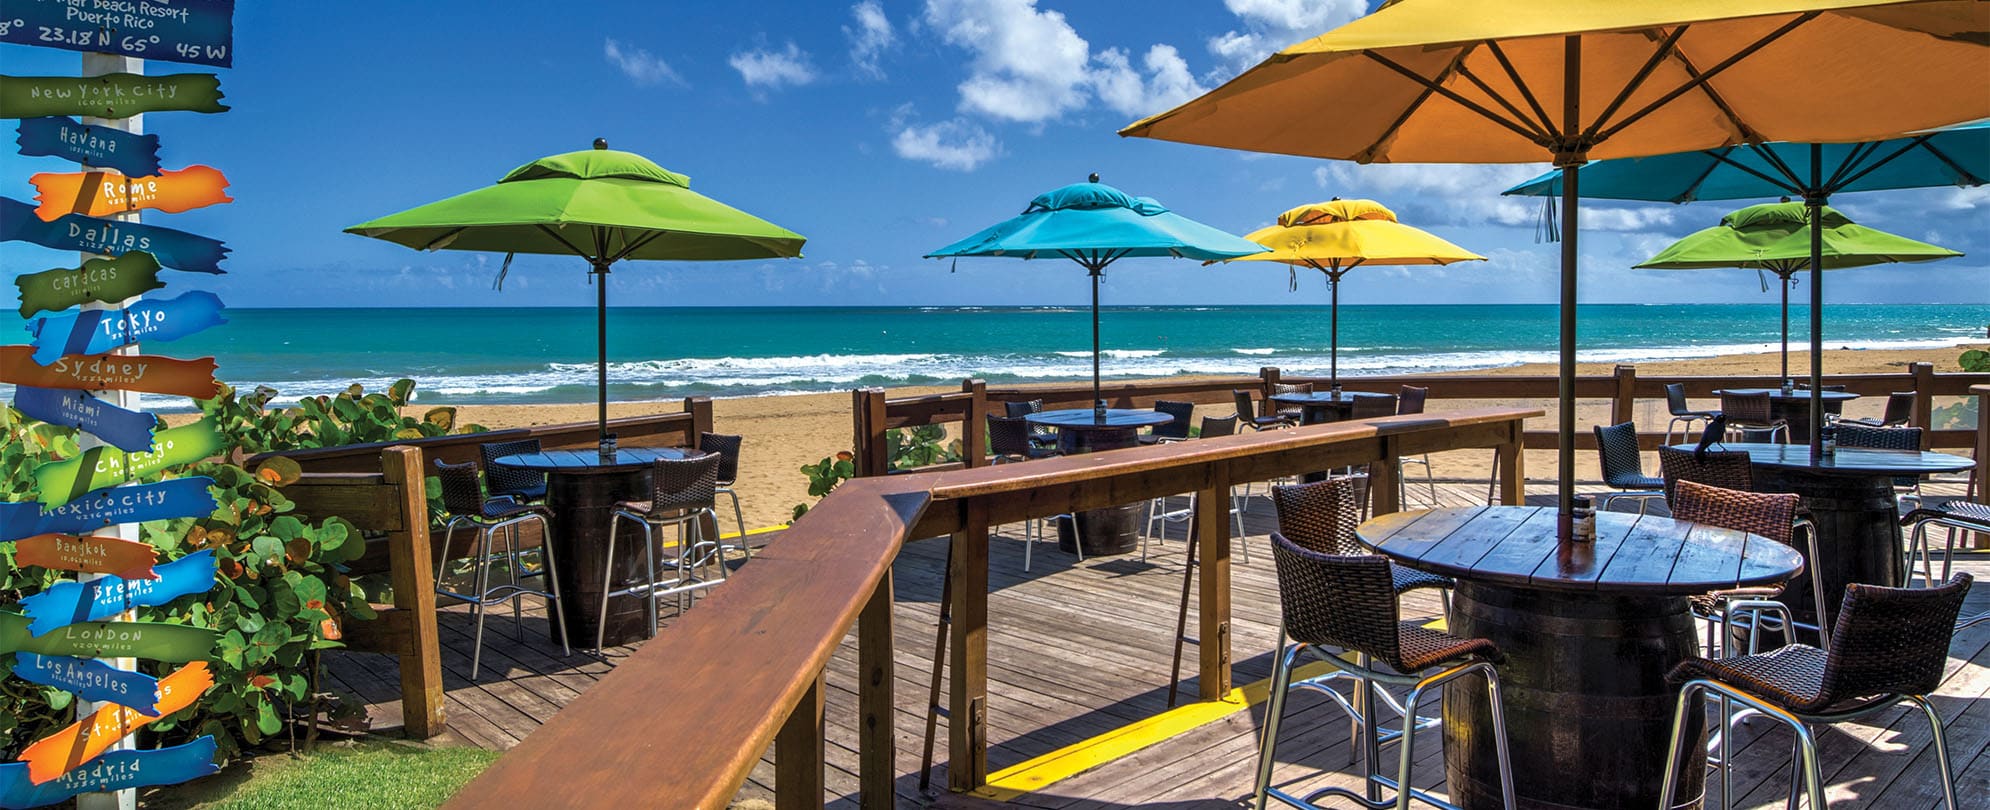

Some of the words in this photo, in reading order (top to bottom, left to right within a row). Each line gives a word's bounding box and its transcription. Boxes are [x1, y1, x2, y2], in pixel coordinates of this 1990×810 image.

[66, 6, 120, 28] Puerto
[124, 15, 154, 29] Rico
[94, 0, 136, 14] Beach
[140, 3, 189, 23] Resort
[39, 26, 93, 45] 23.18
[98, 29, 110, 46] N
[176, 43, 201, 58] 45
[206, 46, 226, 59] W
[31, 86, 71, 99] New
[78, 84, 125, 99] York
[133, 84, 177, 99] City
[105, 98, 135, 106] miles
[60, 126, 116, 153] Havana
[85, 149, 103, 158] miles
[104, 181, 157, 198] Rome
[131, 194, 156, 202] miles
[69, 223, 150, 249] Dallas
[134, 325, 158, 336] miles
[55, 356, 148, 380] Sydney
[62, 396, 100, 417] Miami
[79, 416, 97, 426] miles
[137, 459, 161, 469] miles
[122, 490, 166, 506] City
[105, 507, 135, 517] miles
[56, 538, 107, 557] Bangkok
[84, 558, 102, 566] miles
[93, 575, 163, 601] Bremen
[126, 586, 153, 599] miles
[36, 654, 62, 674] Los
[66, 662, 128, 694] Angeles
[56, 758, 140, 783] Madrid
[100, 773, 134, 784] miles
